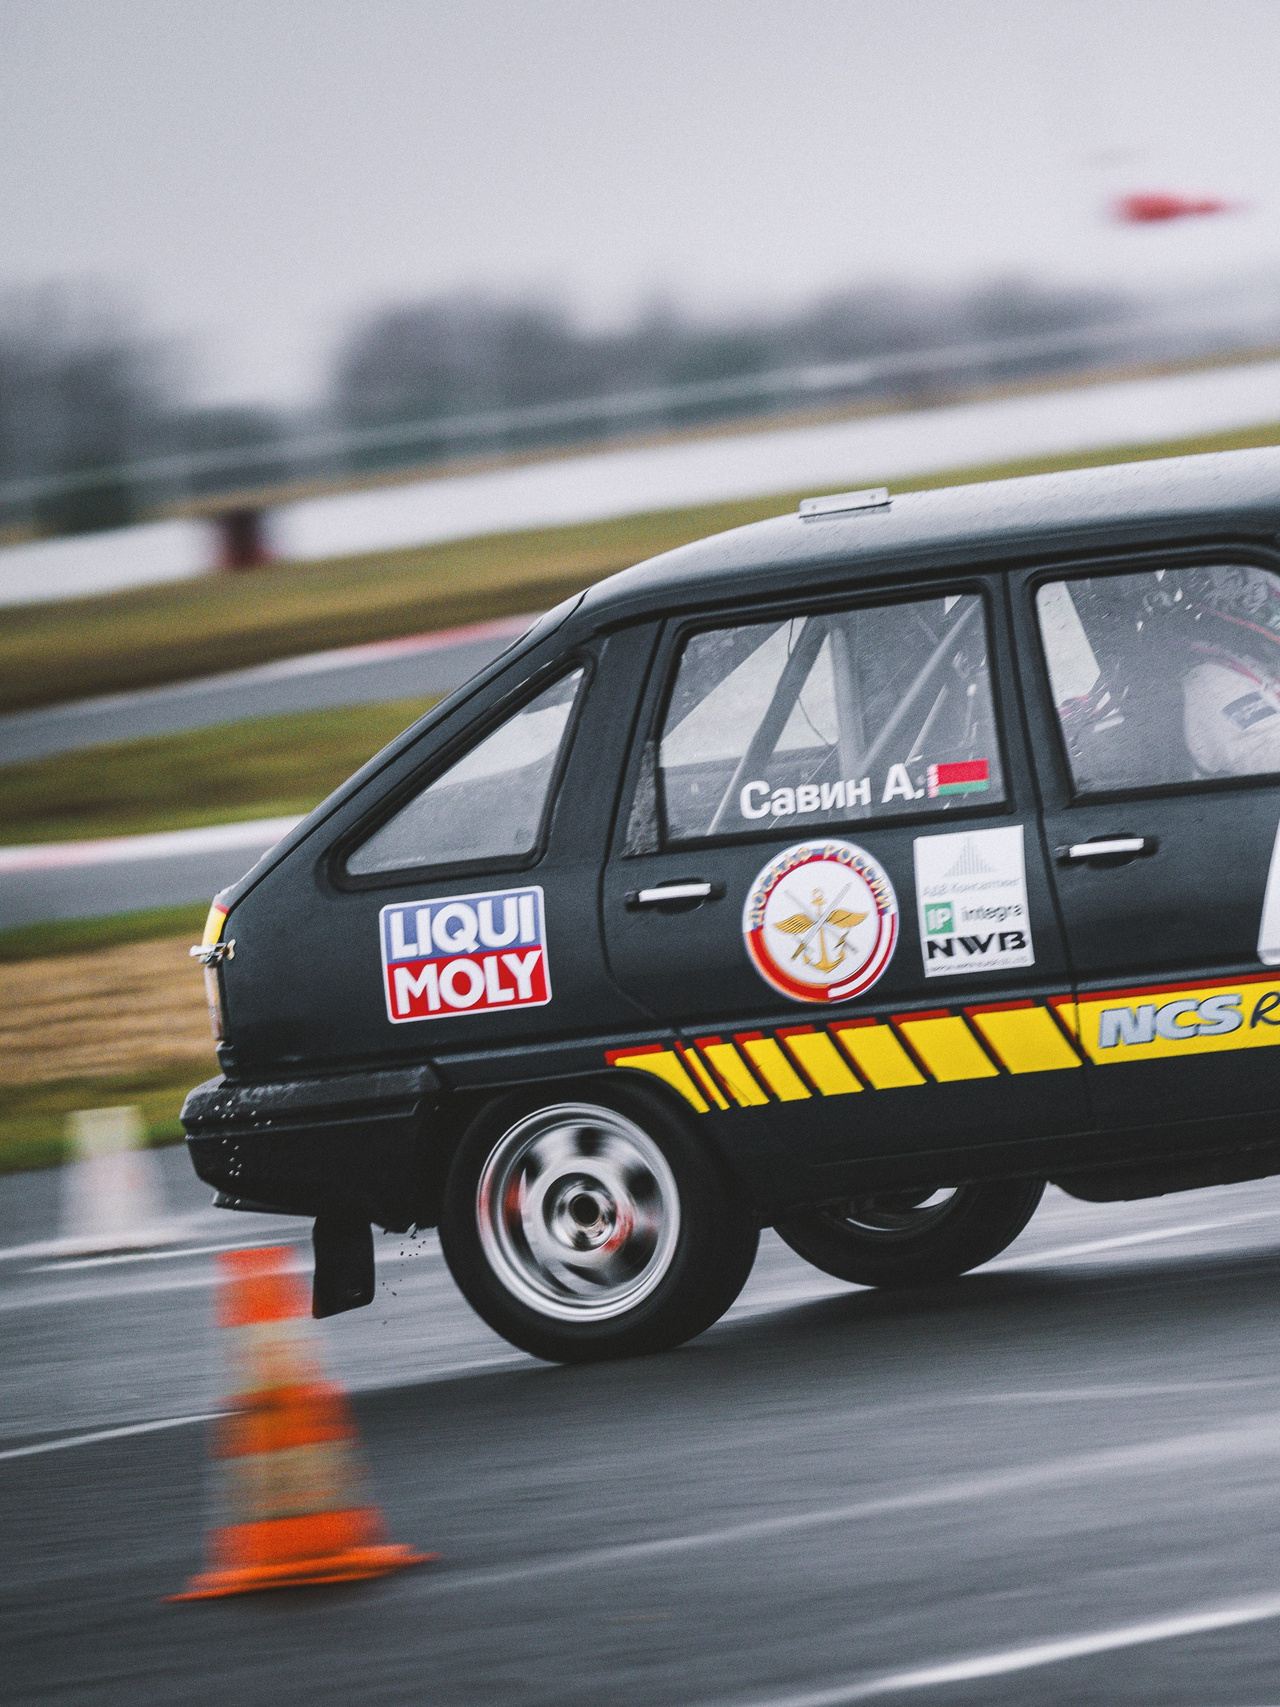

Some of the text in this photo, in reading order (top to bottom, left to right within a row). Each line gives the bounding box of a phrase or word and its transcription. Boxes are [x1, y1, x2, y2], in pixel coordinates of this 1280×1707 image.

[740, 777, 872, 819] Савин
[390, 894, 536, 960] LIQUI
[926, 930, 1027, 959] NWB
[393, 949, 543, 1015] MOLY
[1098, 994, 1244, 1048] NCS
